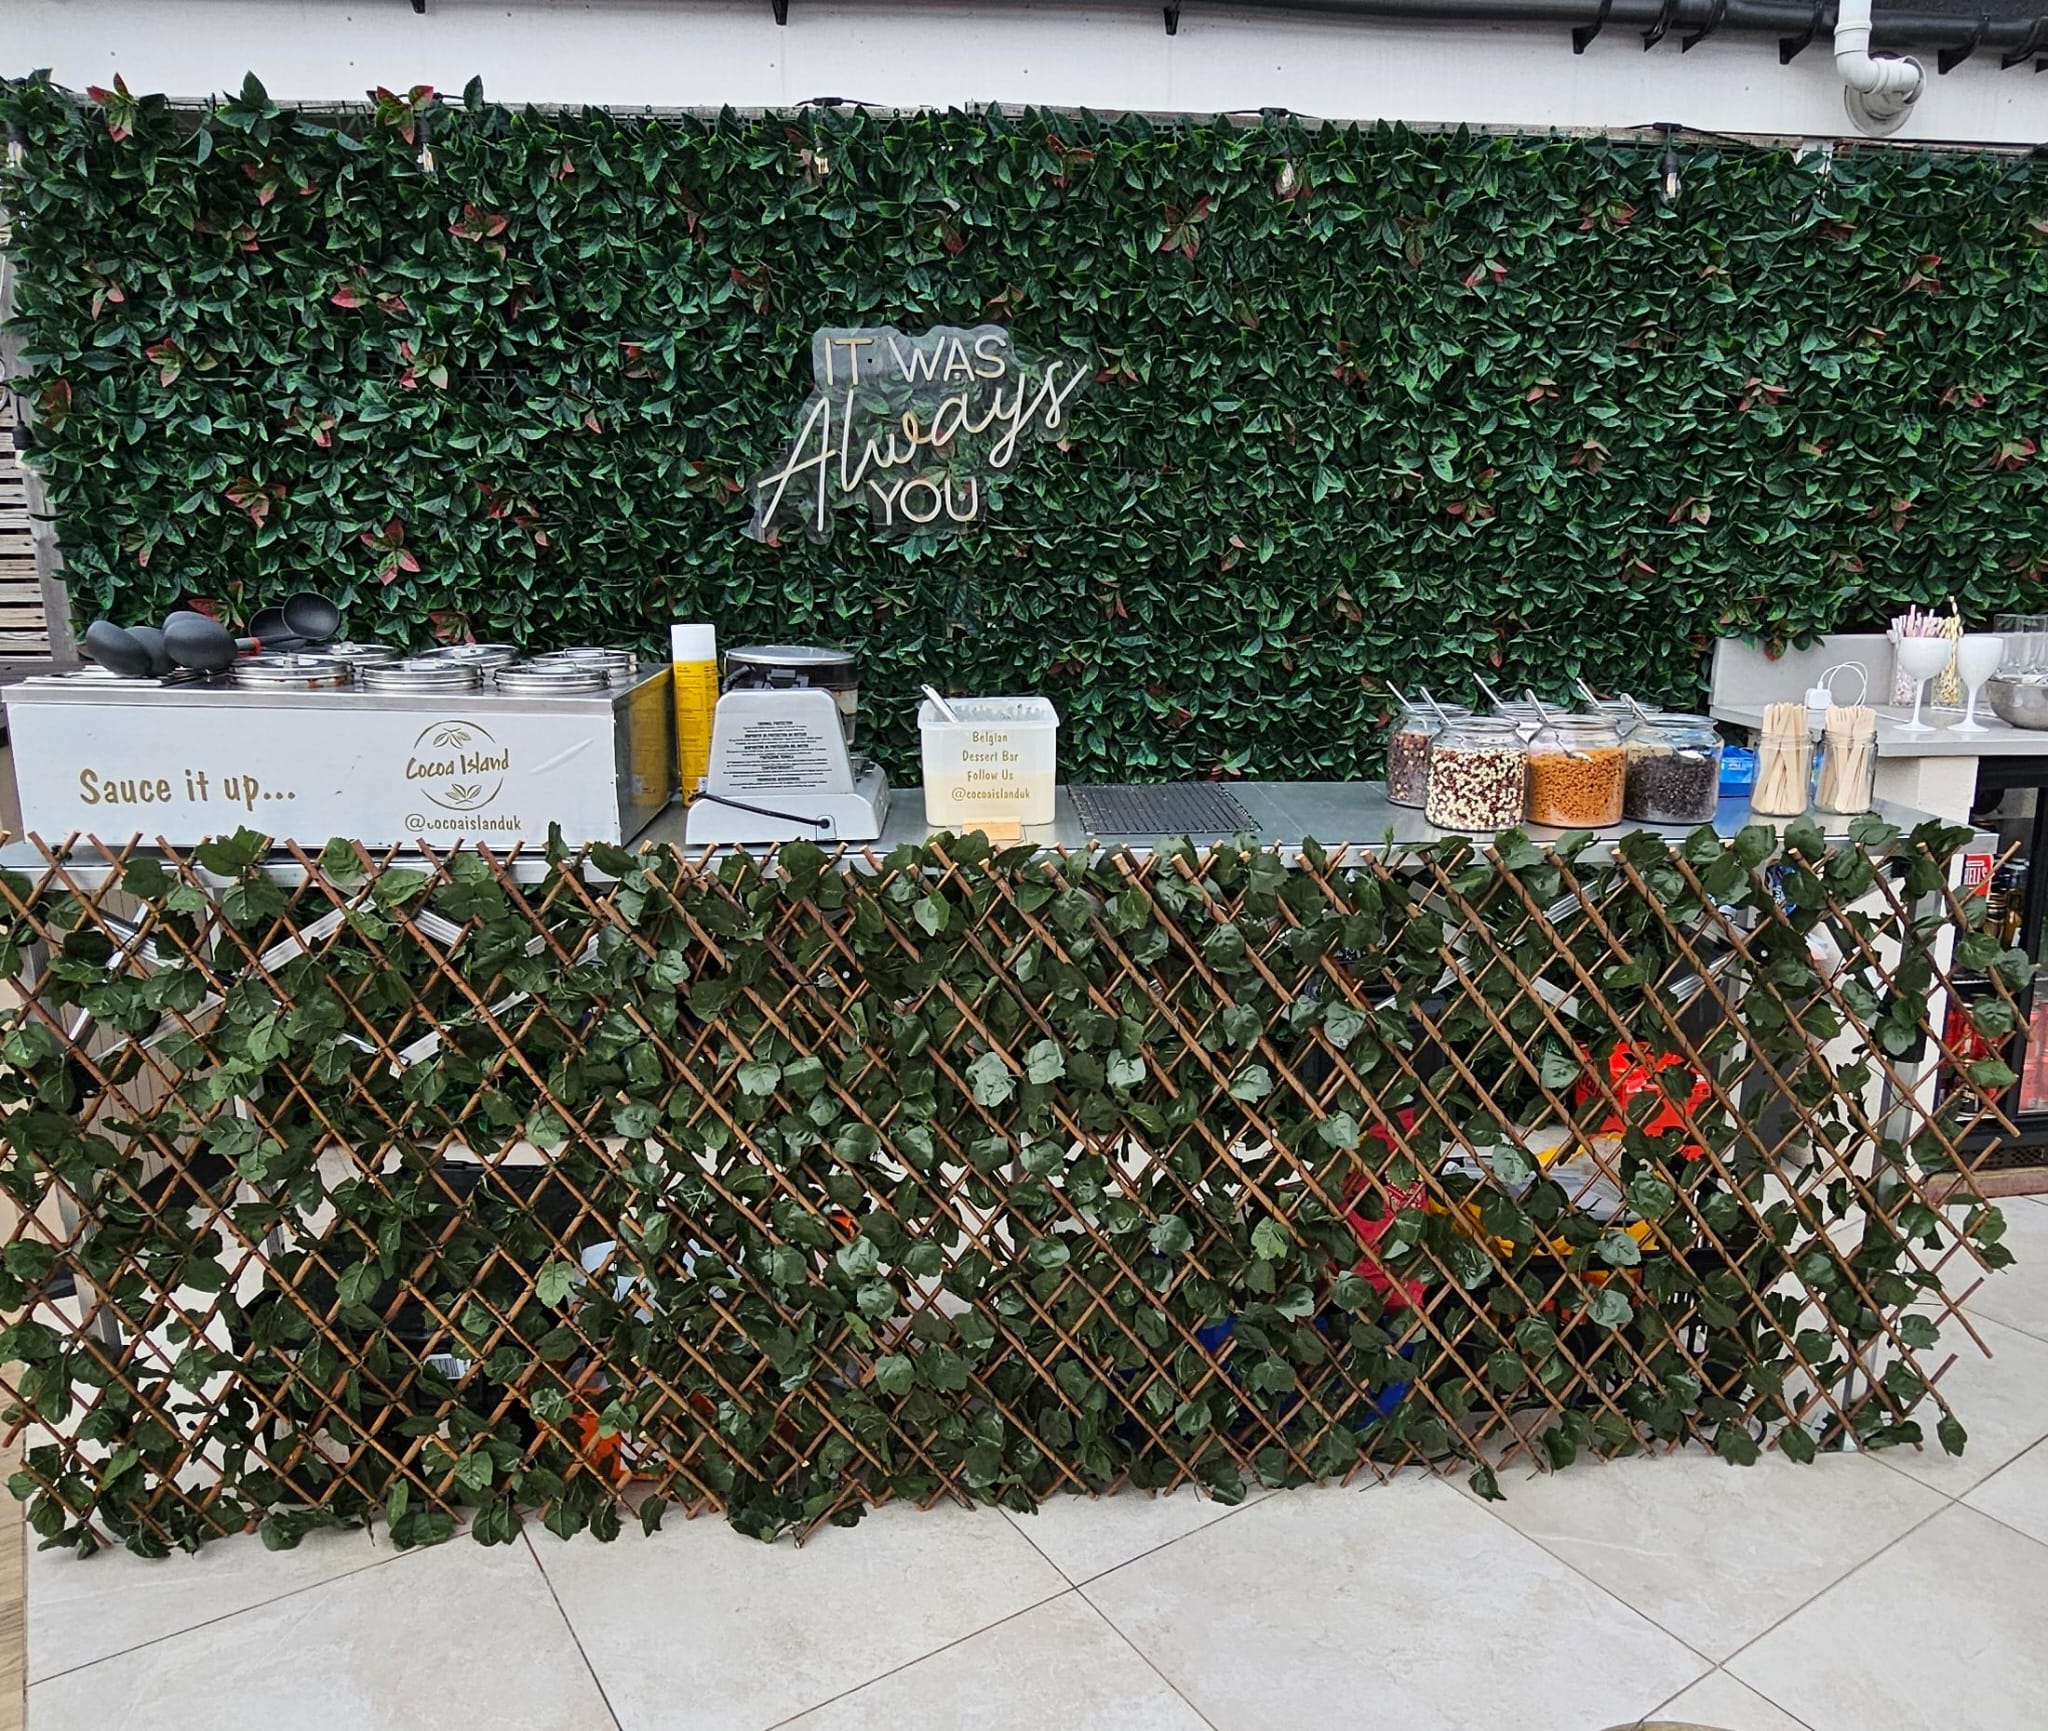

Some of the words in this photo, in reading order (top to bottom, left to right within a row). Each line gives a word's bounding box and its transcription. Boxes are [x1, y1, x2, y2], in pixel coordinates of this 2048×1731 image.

[825, 337, 875, 386] IT
[887, 334, 1007, 383] WAS
[757, 361, 1088, 532] Always
[868, 477, 979, 525] YOU
[972, 731, 1008, 746] Belgian
[406, 757, 455, 779] Cocoa
[460, 748, 509, 775] Island
[962, 750, 998, 762] Dessert
[1002, 750, 1019, 762] Bar
[80, 768, 172, 805] Sauce
[185, 769, 209, 801] it
[224, 775, 296, 812] up...
[967, 769, 998, 782] Follow
[1002, 769, 1014, 781] Us
[951, 787, 1031, 801] @cocoaislanduk
